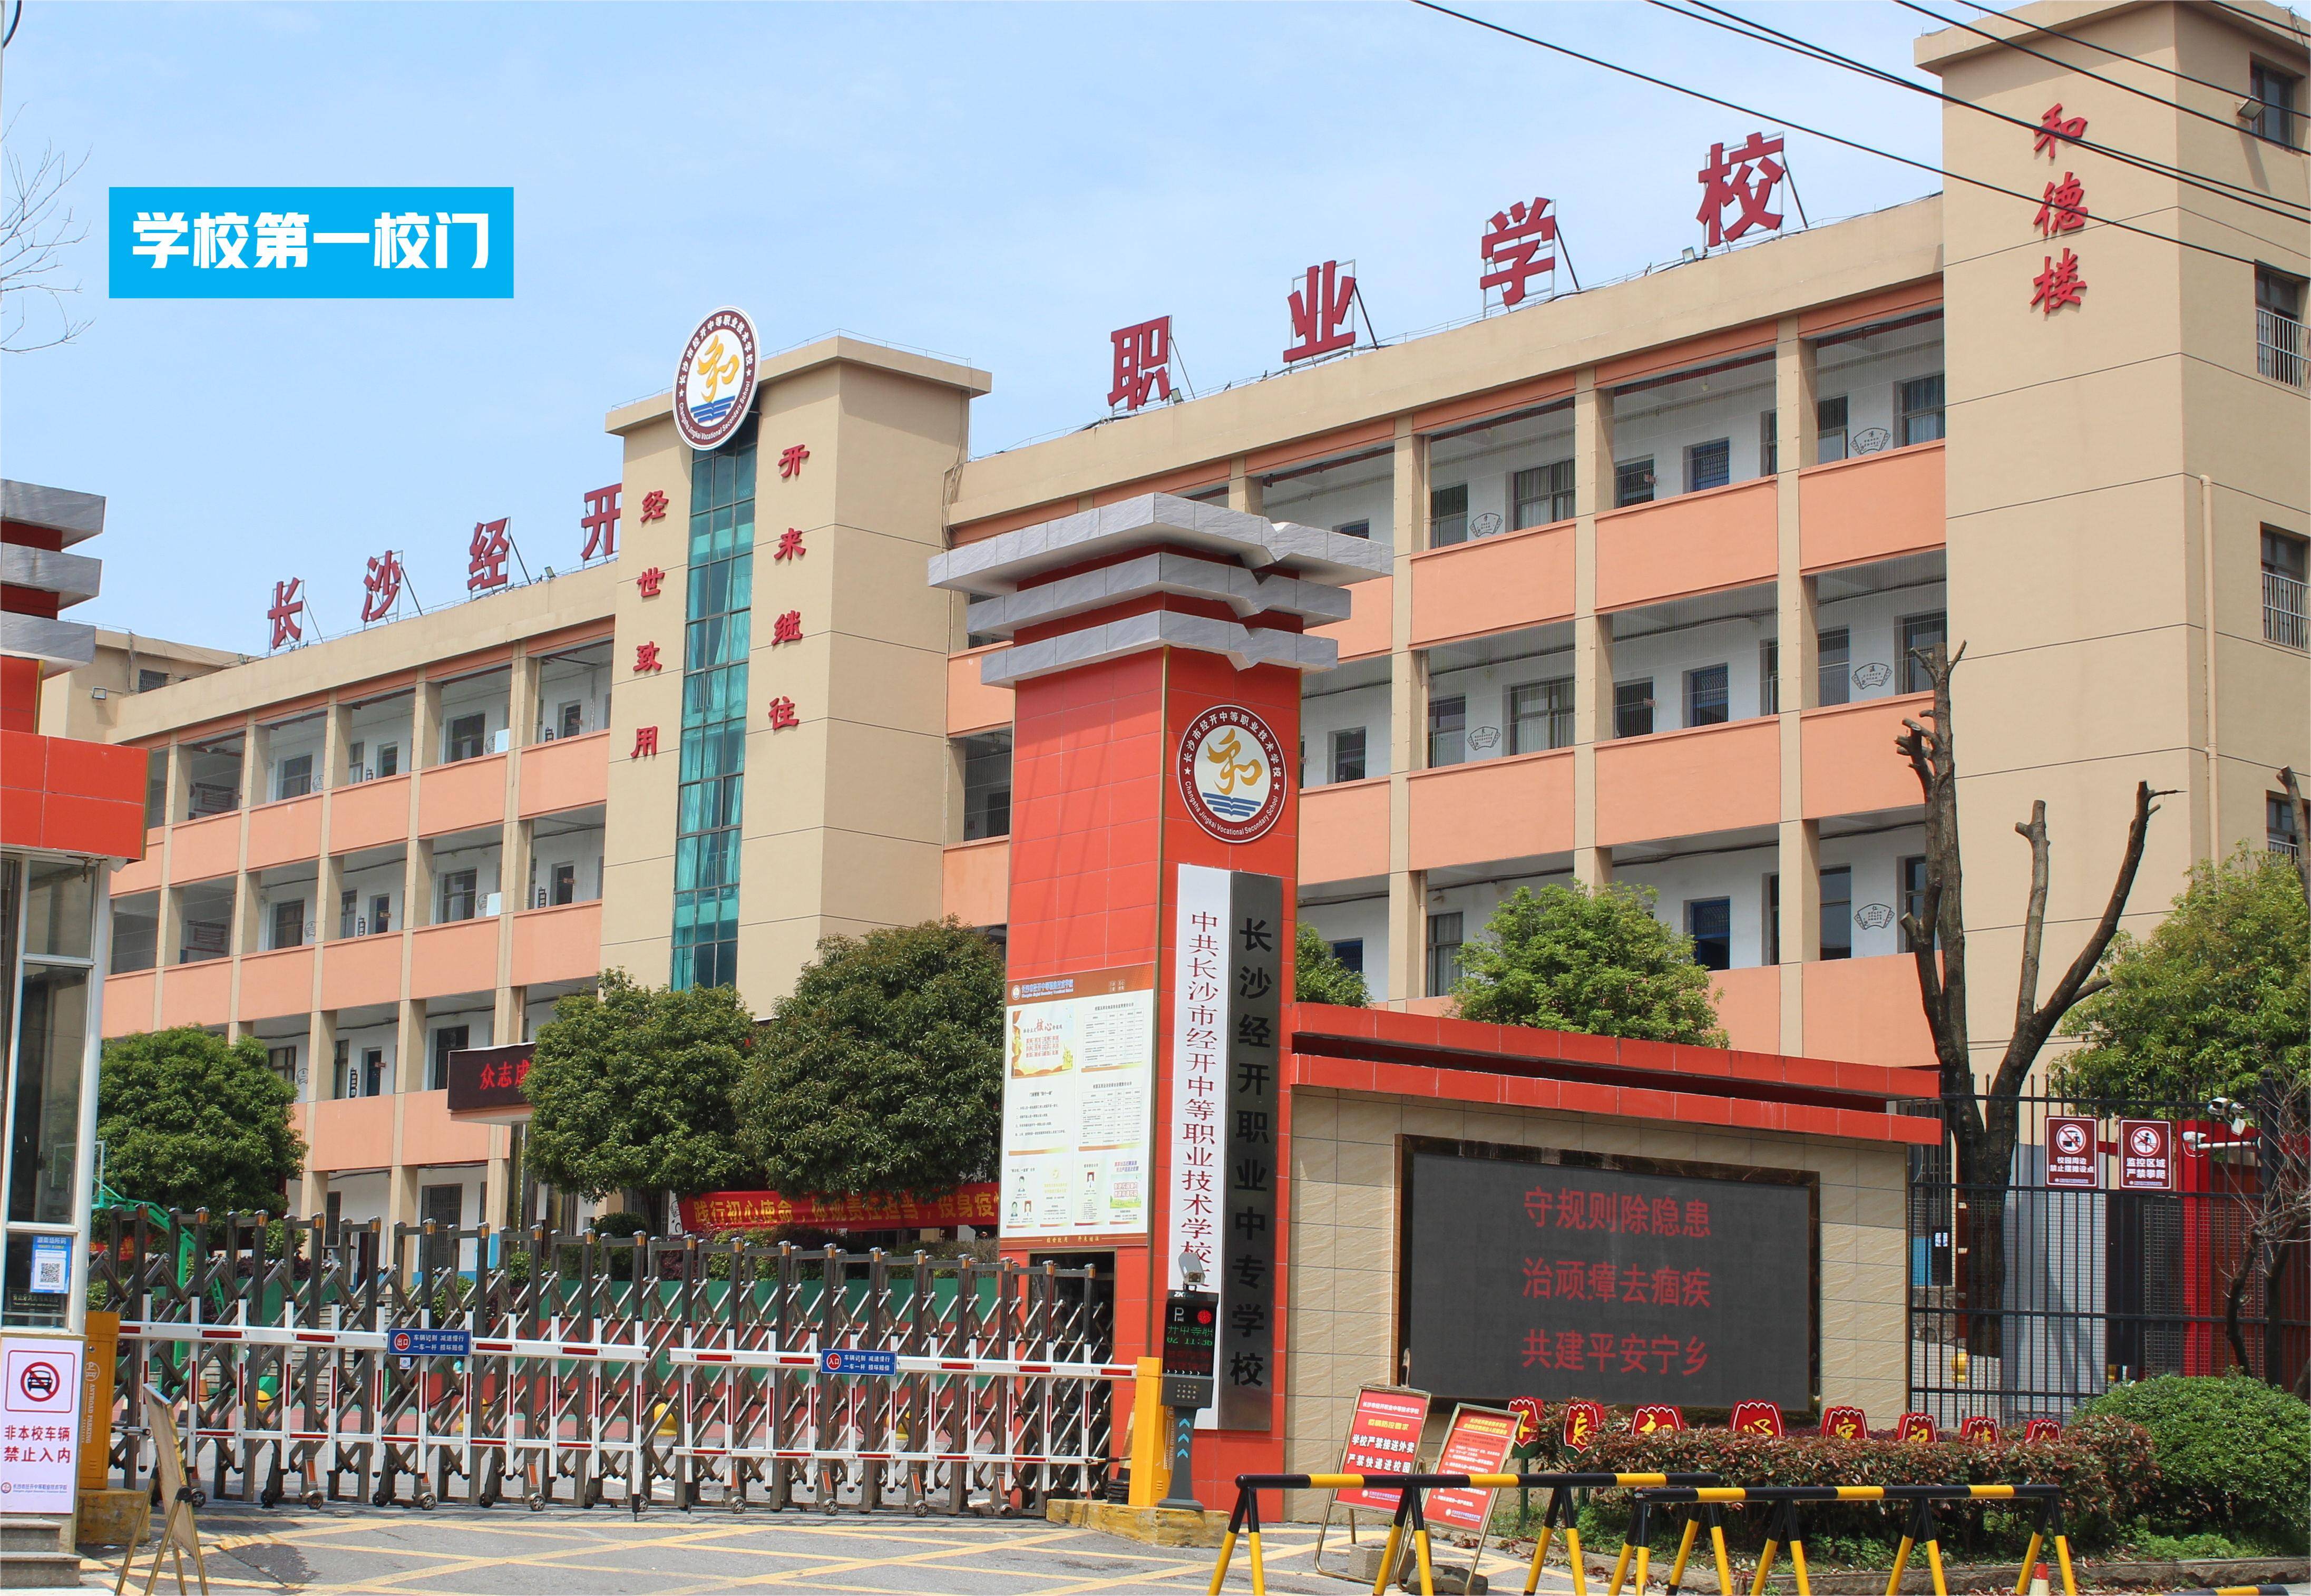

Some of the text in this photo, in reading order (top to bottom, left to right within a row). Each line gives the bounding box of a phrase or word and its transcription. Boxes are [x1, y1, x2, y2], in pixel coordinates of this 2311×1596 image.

[2030, 103, 2088, 314] 和德楼
[268, 132, 1785, 649] 长沙经开 职业学校
[740, 381, 750, 403] School
[768, 444, 810, 731] 开来继往
[630, 490, 669, 759] 经世致用
[1185, 781, 1279, 835] Changsha Jingkai Vocational Secondary School
[1181, 912, 1218, 1287] 中共长沙市经开中等职业技术学校
[1230, 918, 1273, 1387] 长沙经开职业中专学校
[2050, 1165, 2094, 1173] 禁止摆摊设点
[2127, 1157, 2166, 1168] 监控区域
[2127, 1169, 2166, 1179] 严禁攀爬
[1524, 1186, 1711, 1238] 守规则除隐患
[1523, 1257, 1711, 1307] 治顽瘴去痼疾
[1521, 1329, 1709, 1376] 共建平安宁乡
[4, 1424, 71, 1442] 非本校车辆
[4, 1445, 71, 1464] 禁止入内
[1352, 1434, 1415, 1454] 学校严禁接送外卖
[1347, 1453, 1411, 1474] 严禁快递进校园
